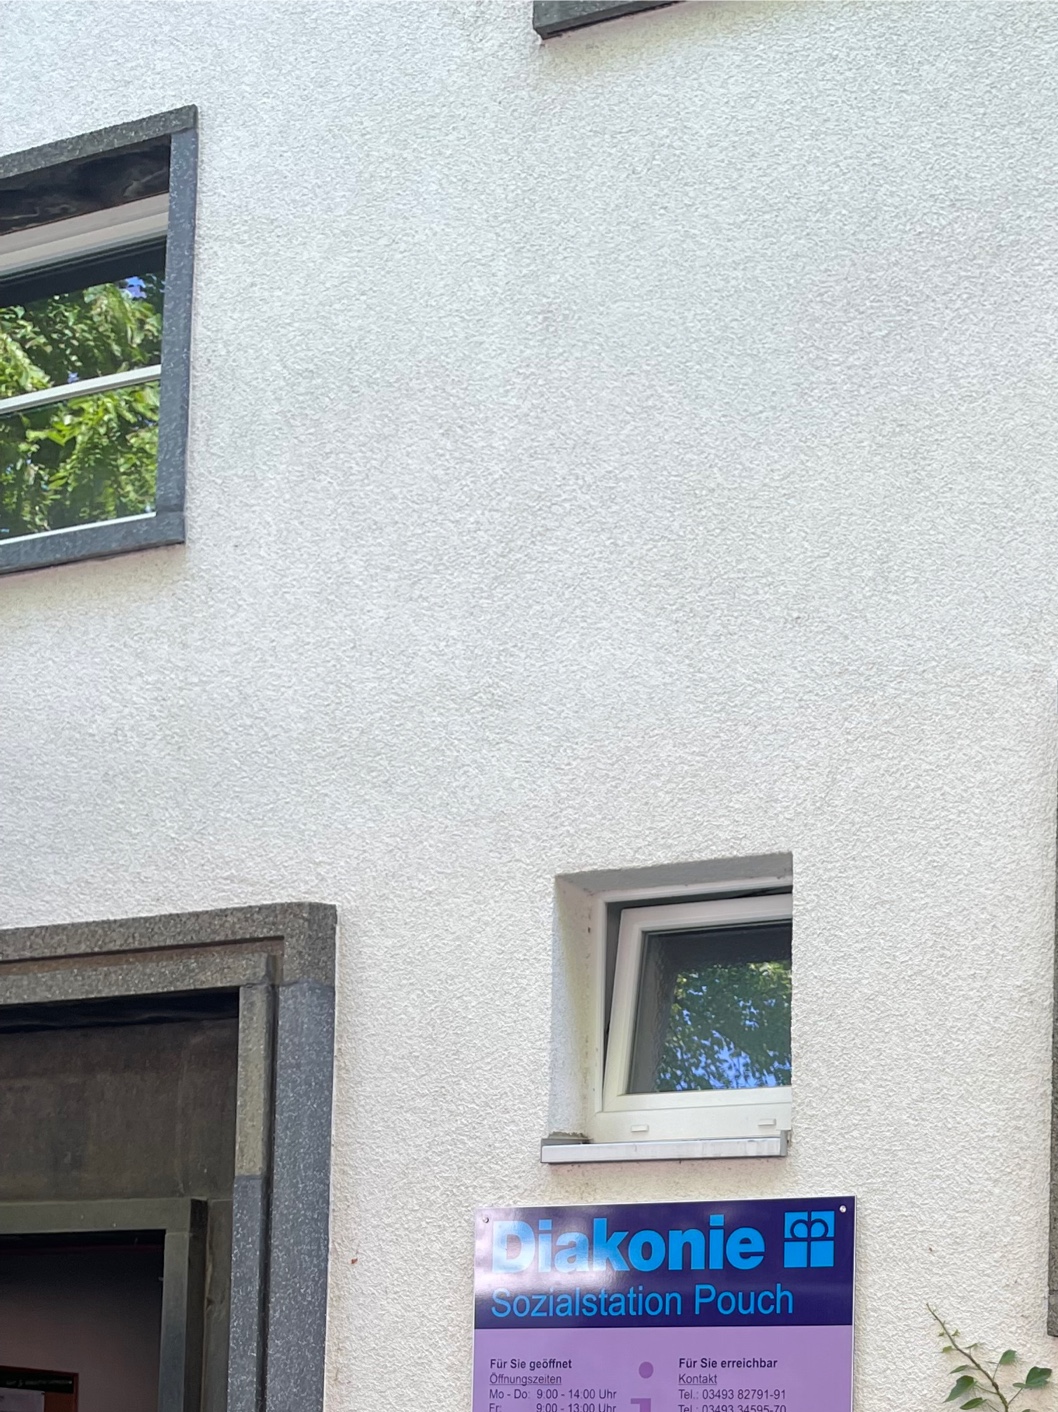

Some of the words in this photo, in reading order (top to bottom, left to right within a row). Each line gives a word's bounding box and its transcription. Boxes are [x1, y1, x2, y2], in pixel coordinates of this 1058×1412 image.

[491, 1214, 765, 1274] Diakonie
[491, 1286, 682, 1317] Sozialstation
[695, 1283, 794, 1315] Pouch
[490, 1359, 507, 1369] Für
[510, 1359, 526, 1369] Sie
[529, 1358, 573, 1371] geöffnet
[678, 1358, 697, 1369] Für
[700, 1358, 718, 1369] Sie
[720, 1358, 778, 1369] erreichbar
[489, 1372, 562, 1386] Öffnungszeiten
[678, 1373, 718, 1385] Kontakt
[489, 1389, 504, 1399] Mo
[514, 1389, 530, 1399] Do:
[536, 1389, 558, 1399] 9:00
[568, 1389, 596, 1399] 14:00
[599, 1389, 617, 1399] Uhr
[678, 1389, 699, 1400] Tel.:
[702, 1389, 734, 1400] 03493
[737, 1389, 786, 1400] 82791-91
[489, 1403, 502, 1412] Fr:
[536, 1403, 558, 1412] 9:00
[568, 1403, 595, 1412] 13:00
[598, 1403, 616, 1412] Uhr
